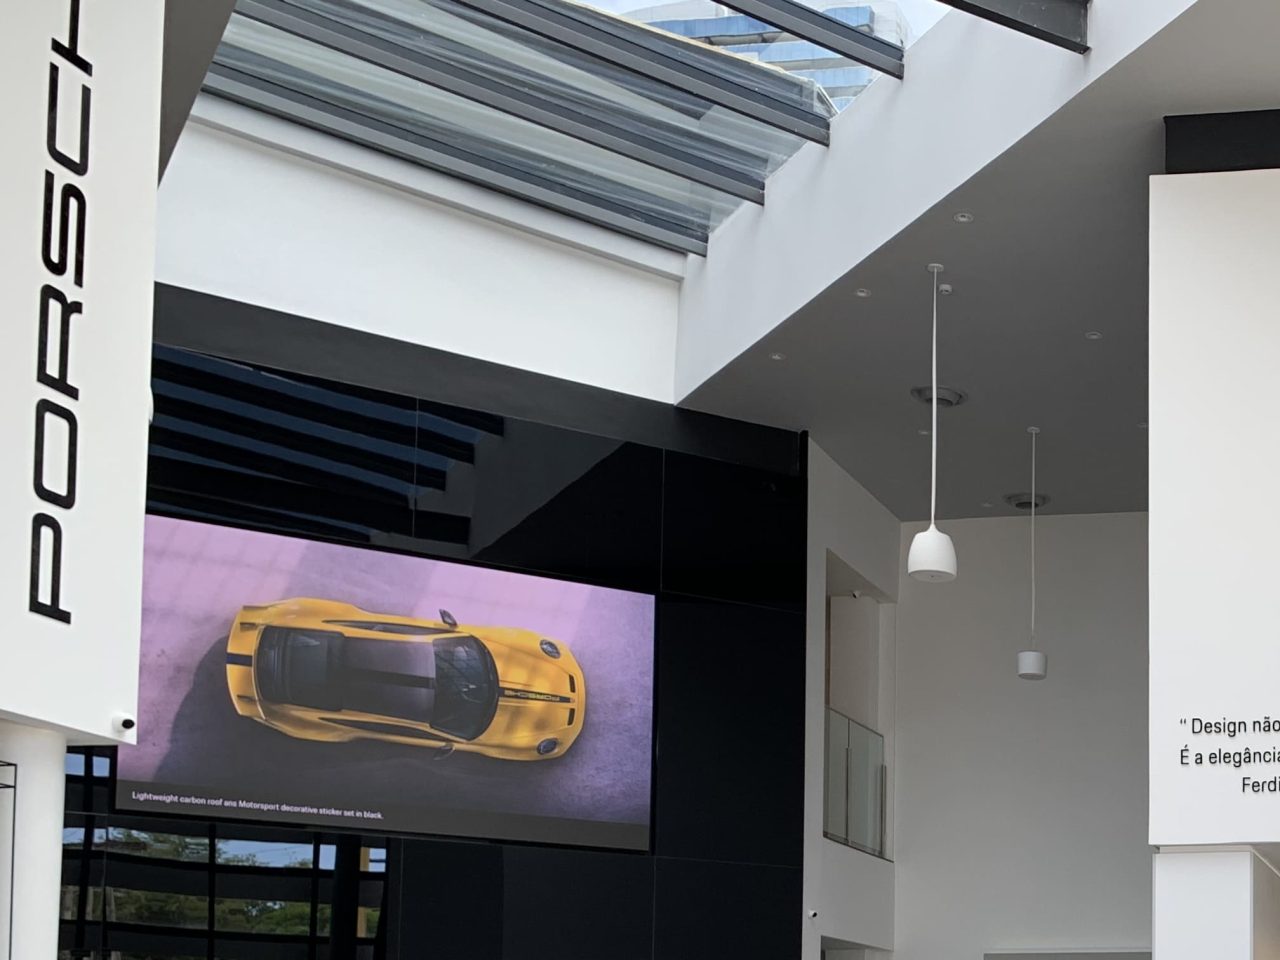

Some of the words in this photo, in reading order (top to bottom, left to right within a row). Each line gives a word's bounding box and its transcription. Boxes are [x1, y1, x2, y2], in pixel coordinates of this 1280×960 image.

[1180, 744, 1190, 766] É
[1194, 752, 1203, 765] a
[132, 791, 179, 804] Lightweight
[179, 796, 206, 805] carbon
[207, 798, 223, 806] roof
[238, 800, 280, 812] Motorsport
[280, 804, 318, 814] decorative
[319, 807, 342, 816] sticker
[343, 809, 355, 817] set
[355, 810, 363, 818] in
